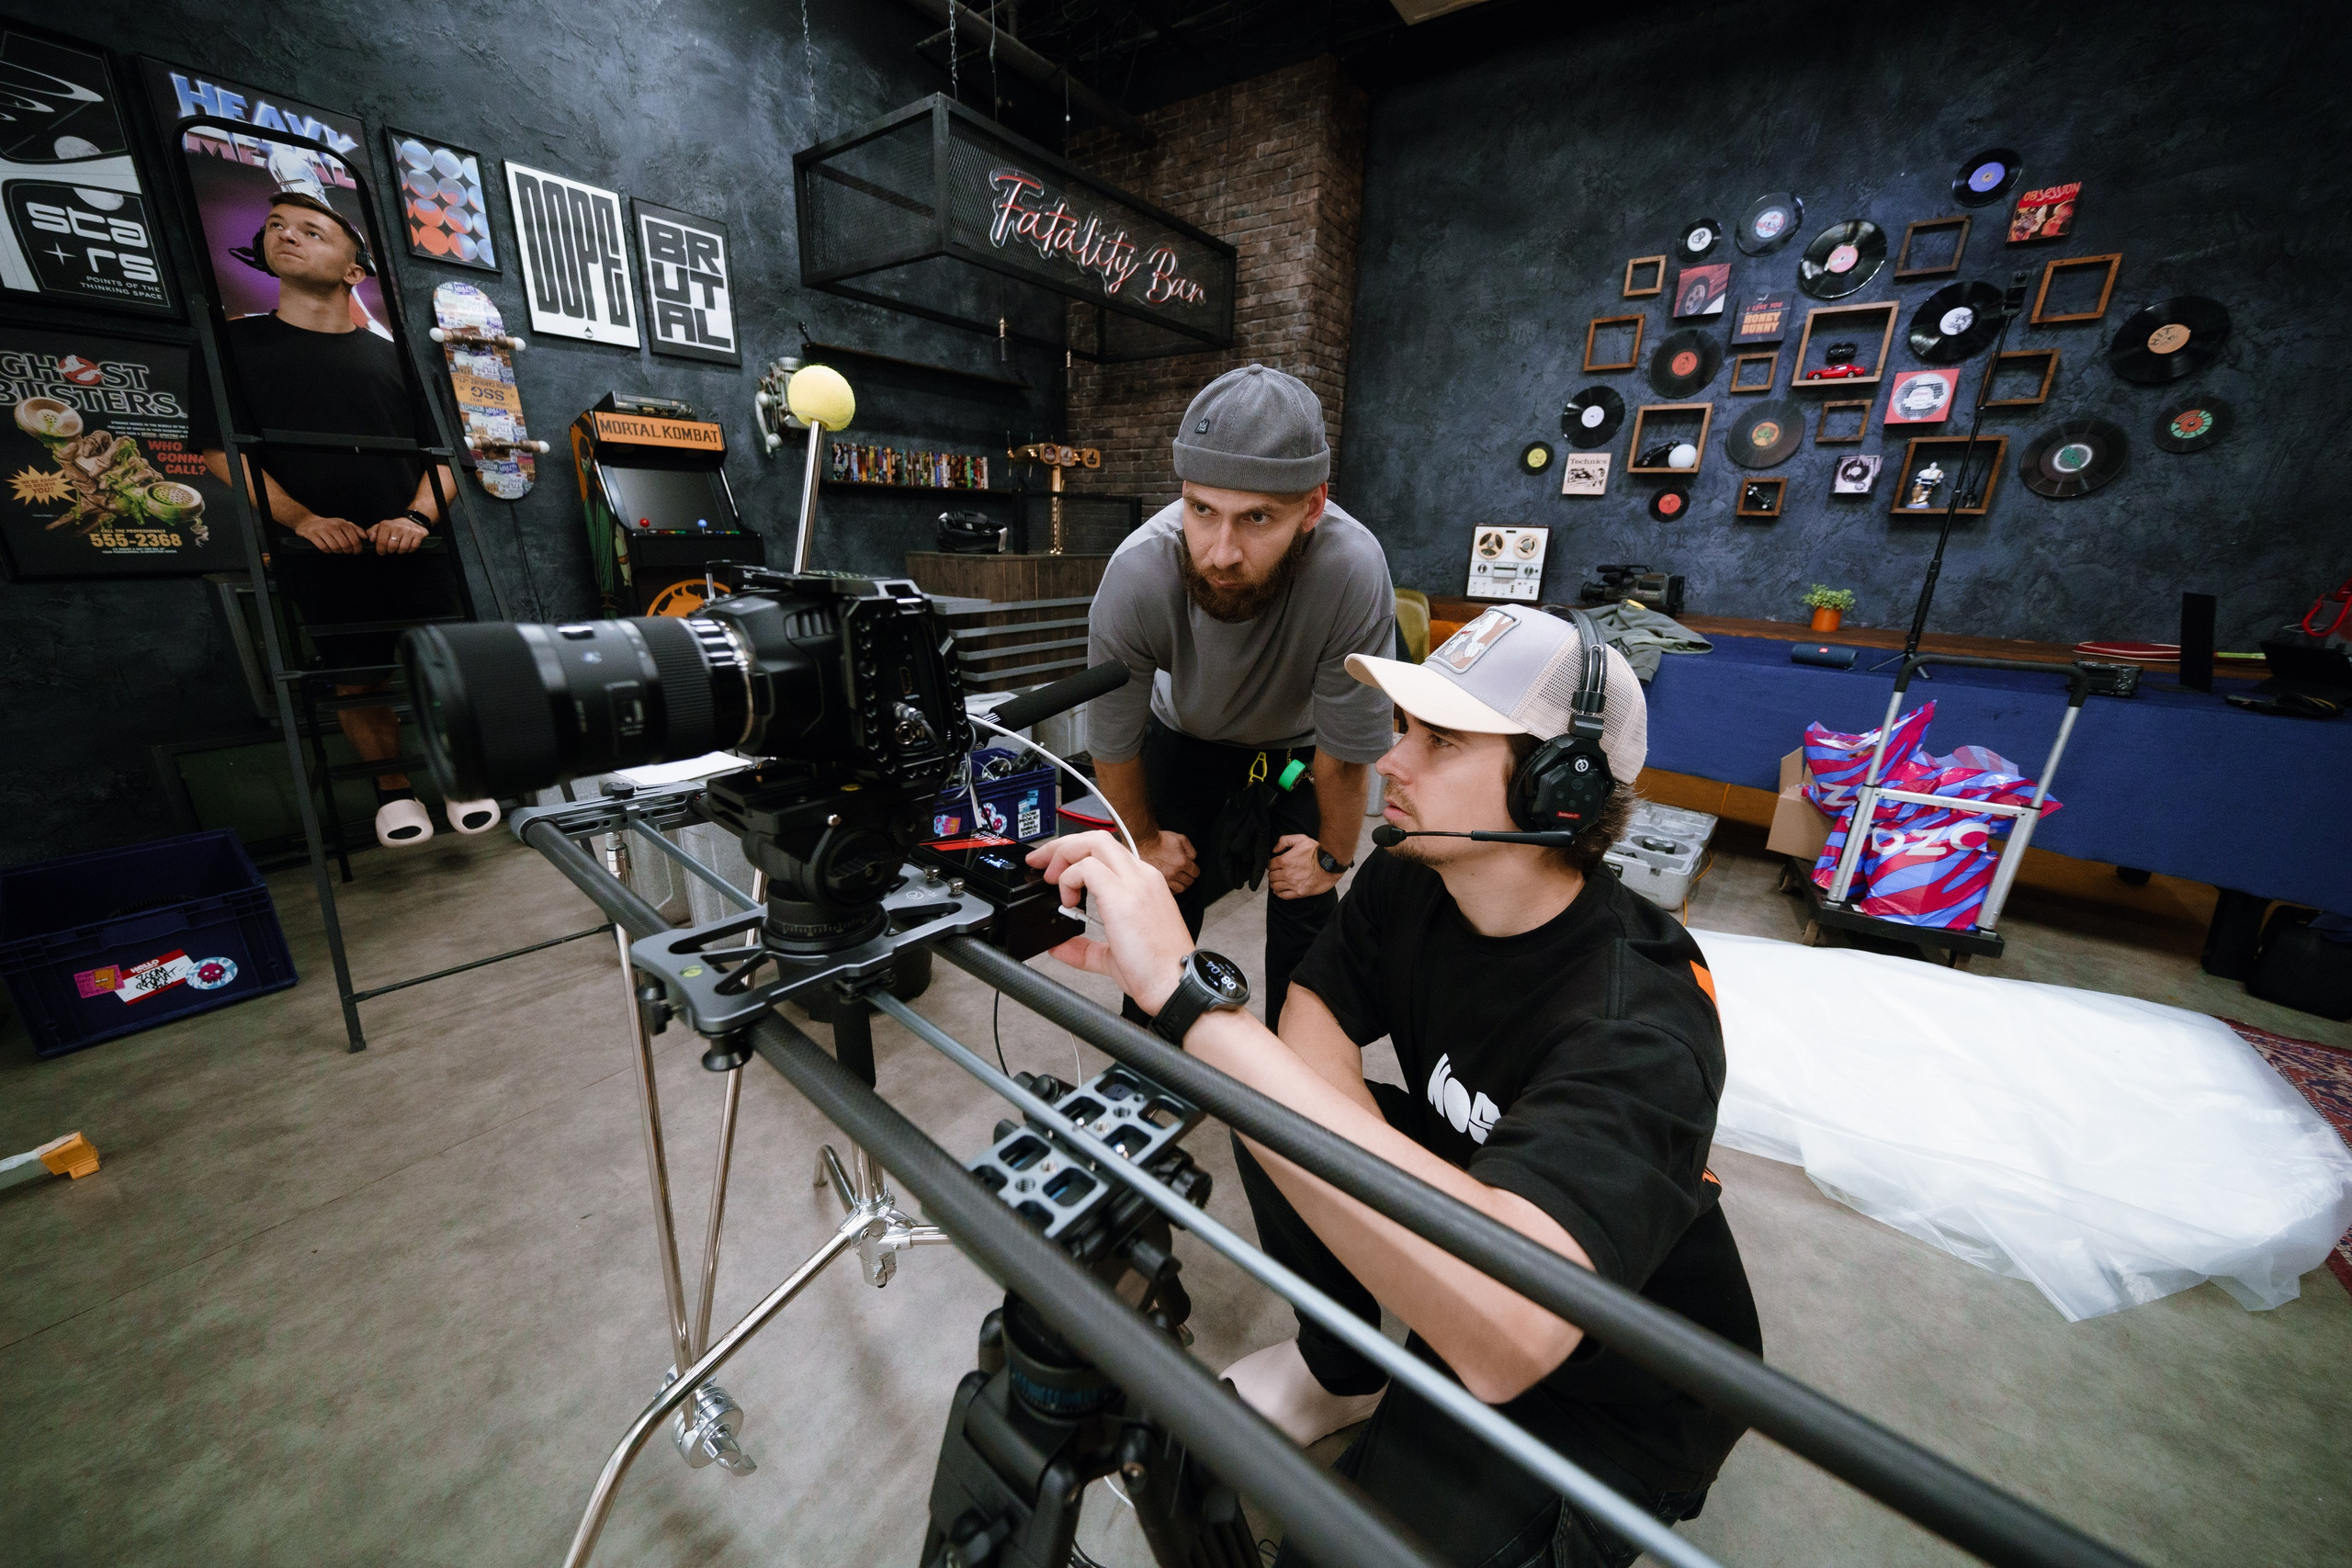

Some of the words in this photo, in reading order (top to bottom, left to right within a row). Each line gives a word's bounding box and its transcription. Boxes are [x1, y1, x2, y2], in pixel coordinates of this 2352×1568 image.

[169, 72, 359, 154] HEAVY
[991, 173, 1140, 295] Fatality
[1147, 247, 1205, 303] Bar
[514, 171, 630, 328] DOPE
[80, 281, 130, 295] THINKING
[132, 289, 164, 300] SPACE
[85, 276, 123, 287] POINTS
[141, 285, 162, 293] THE
[1744, 311, 1781, 323] HONEY
[1740, 321, 1781, 335] BUNNY
[470, 386, 505, 401] SSG
[599, 419, 662, 439] MORTAL
[662, 424, 719, 444] KOMBAT
[147, 440, 184, 452] WHO
[156, 452, 206, 465] GONNA
[164, 464, 207, 476] CALL?
[32, 486, 54, 494] YOU!
[89, 533, 183, 547] 555-2368
[1022, 810, 1036, 818] ZOOM
